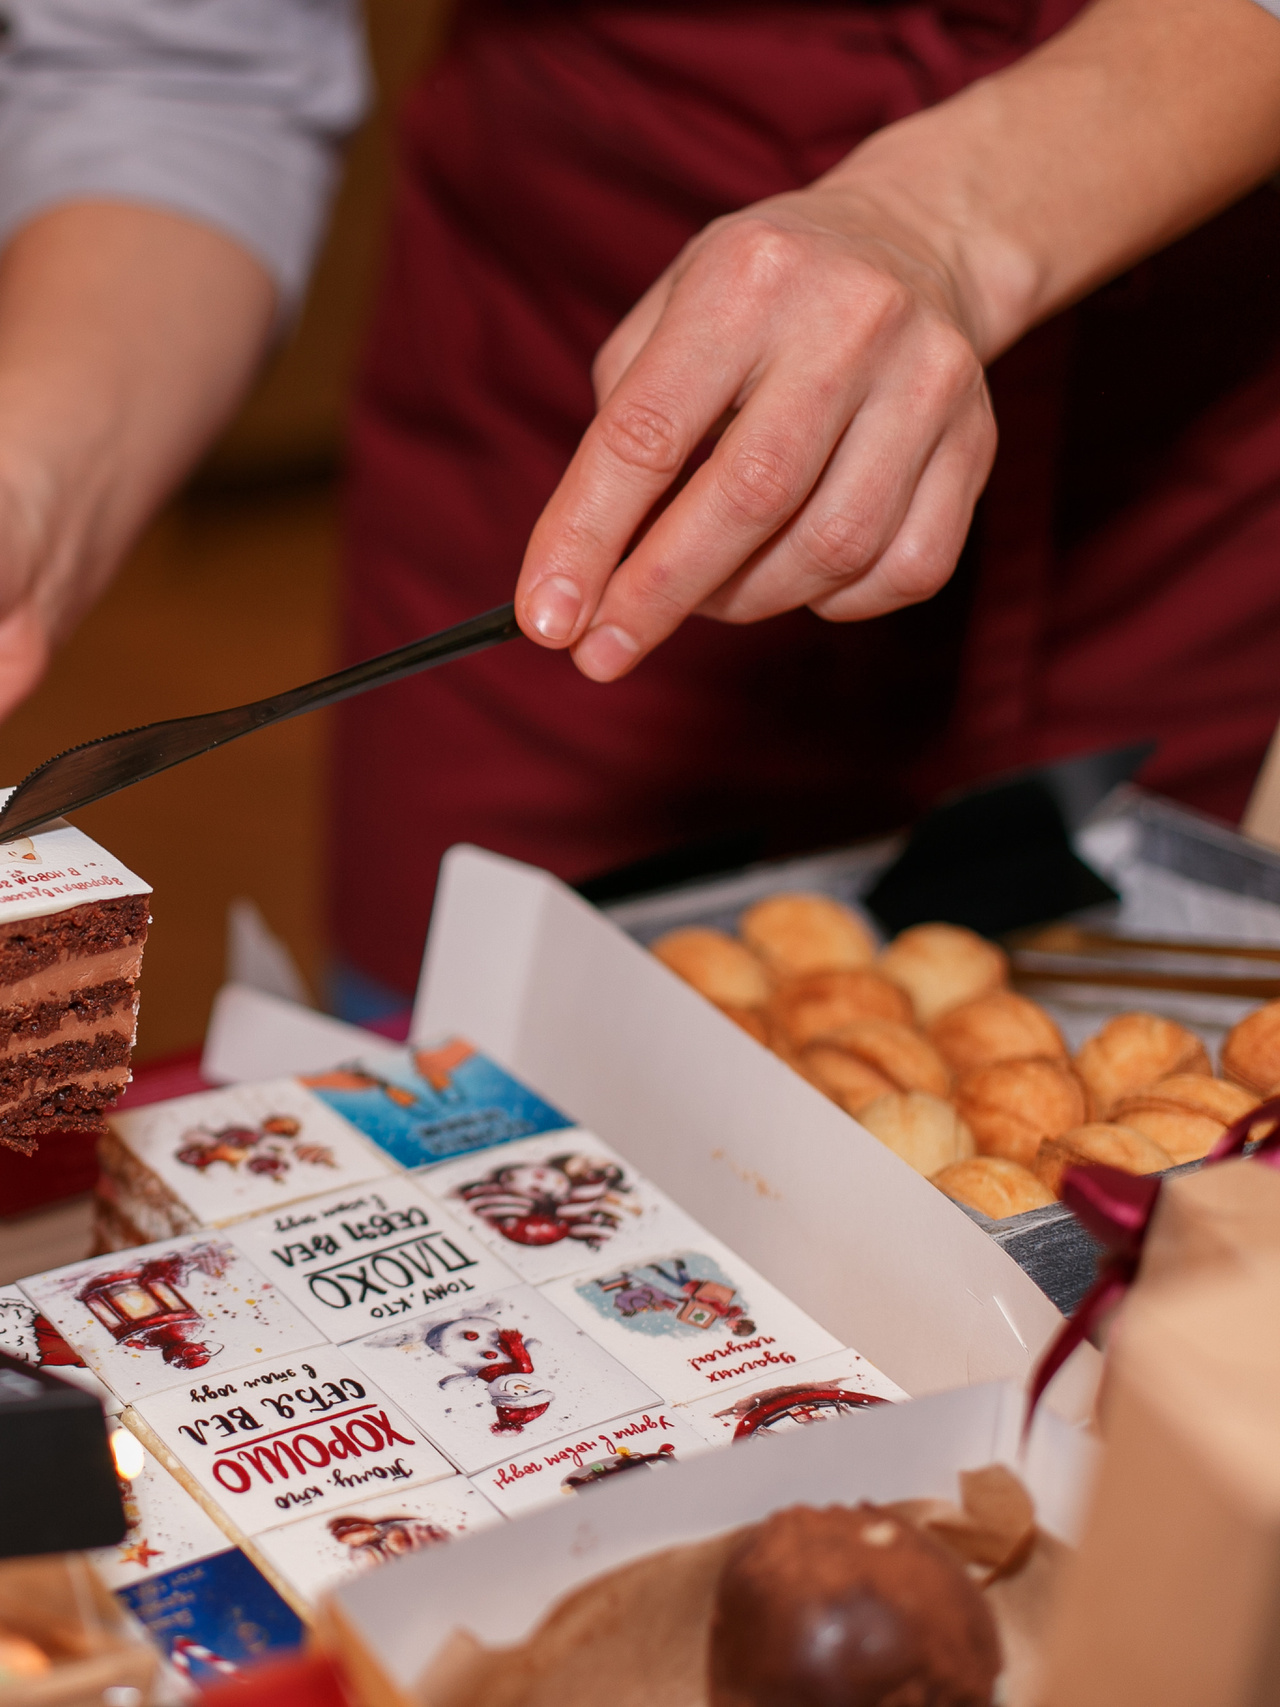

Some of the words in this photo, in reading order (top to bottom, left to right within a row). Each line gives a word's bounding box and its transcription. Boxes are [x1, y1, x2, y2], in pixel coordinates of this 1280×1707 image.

[270, 1235, 341, 1268] ВЕЛ
[307, 1237, 479, 1310] ПЛОХО
[190, 1382, 238, 1406] году
[243, 1367, 297, 1391] этом
[260, 1377, 366, 1419] СЕБЯ
[176, 1406, 263, 1447] ВЕЛ
[211, 1409, 415, 1494] ХОРОШО
[543, 1438, 599, 1469] новом
[491, 1458, 544, 1491] году!
[274, 1486, 324, 1511] кто
